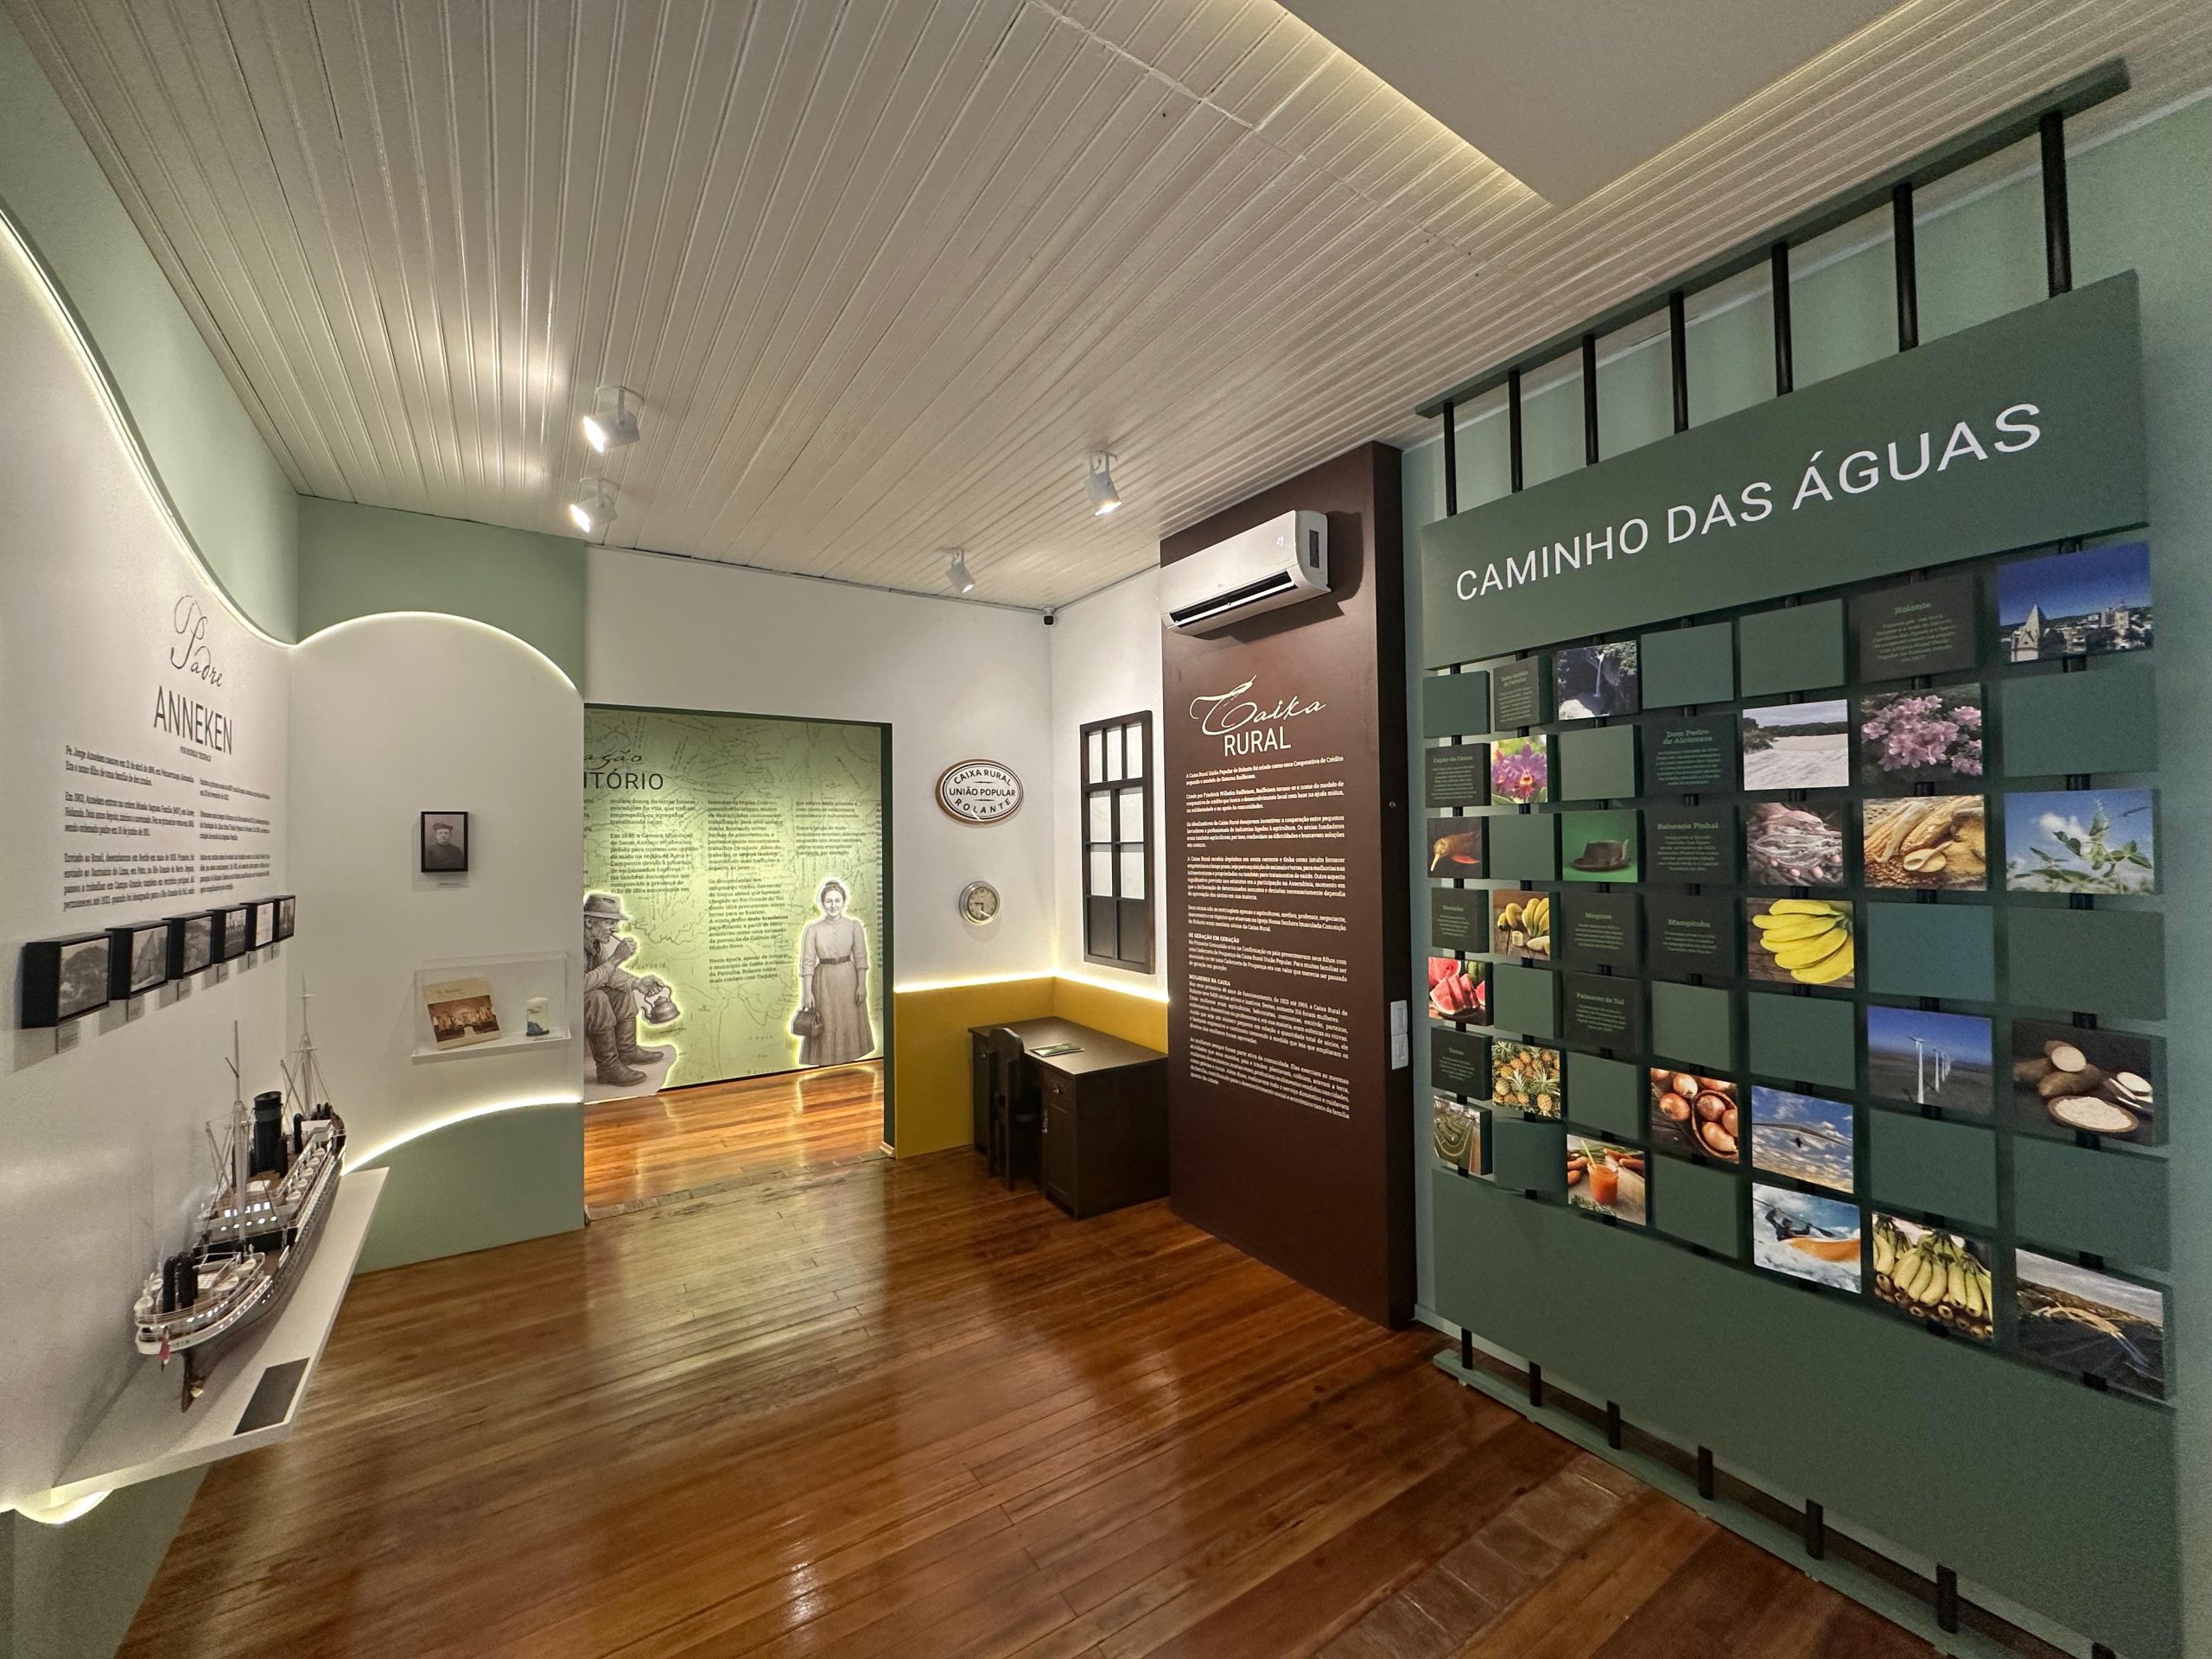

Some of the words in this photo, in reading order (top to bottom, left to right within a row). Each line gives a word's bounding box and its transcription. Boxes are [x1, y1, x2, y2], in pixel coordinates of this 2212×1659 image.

[1456, 518, 1649, 601] CAMINHO
[1668, 481, 1773, 543] DAS
[1793, 403, 2042, 511] ÁGUAS
[1895, 602, 1931, 615] Rolante
[170, 595, 222, 687] Padre
[154, 685, 232, 755] ANNEKEN
[1224, 726, 1291, 757] RURAL
[584, 768, 664, 790] ITÓRIO
[954, 769, 982, 784] CAIXA
[983, 769, 1011, 786] RURAL
[950, 786, 977, 796] UNIÃO
[955, 798, 1011, 814] ROLANTE
